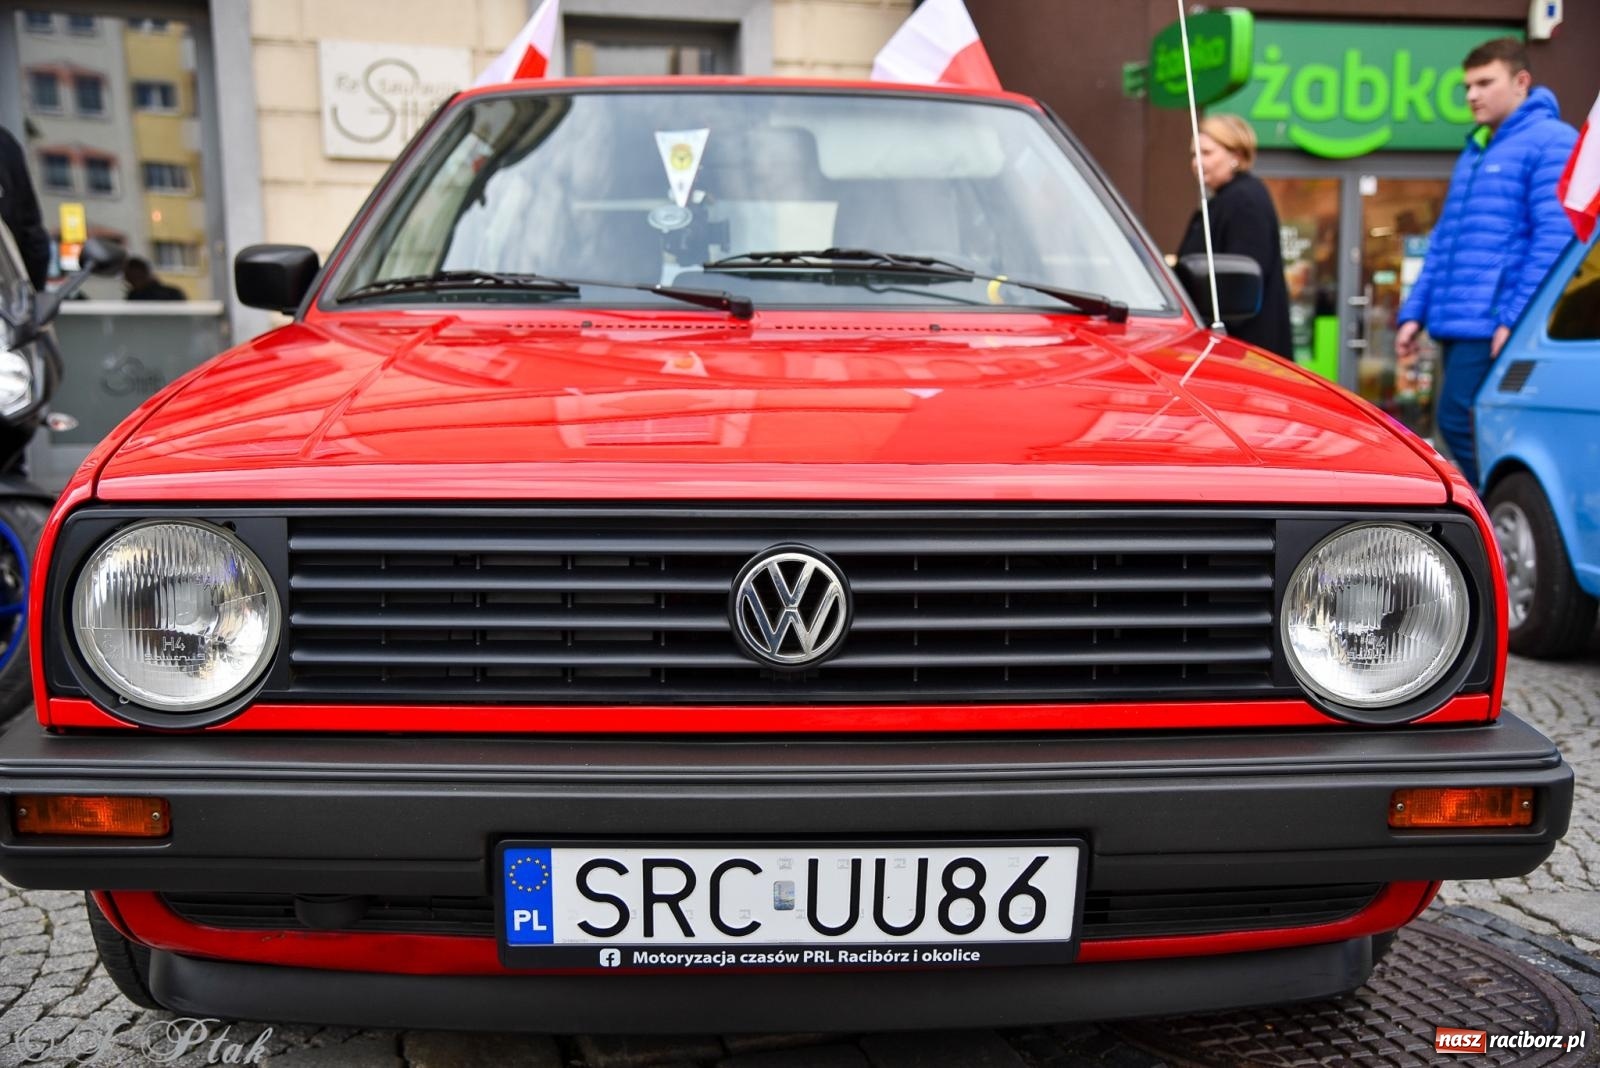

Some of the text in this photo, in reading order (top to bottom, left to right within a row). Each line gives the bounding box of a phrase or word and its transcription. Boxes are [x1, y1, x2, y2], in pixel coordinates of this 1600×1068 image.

[575, 855, 1050, 938] SRC UU86
[513, 909, 547, 931] PL
[632, 950, 736, 967] Motoryzacja
[740, 949, 799, 964] czasów
[803, 950, 834, 963] PRL
[838, 949, 910, 964] Racibórz
[913, 949, 918, 962] i
[921, 948, 981, 963] okolice
